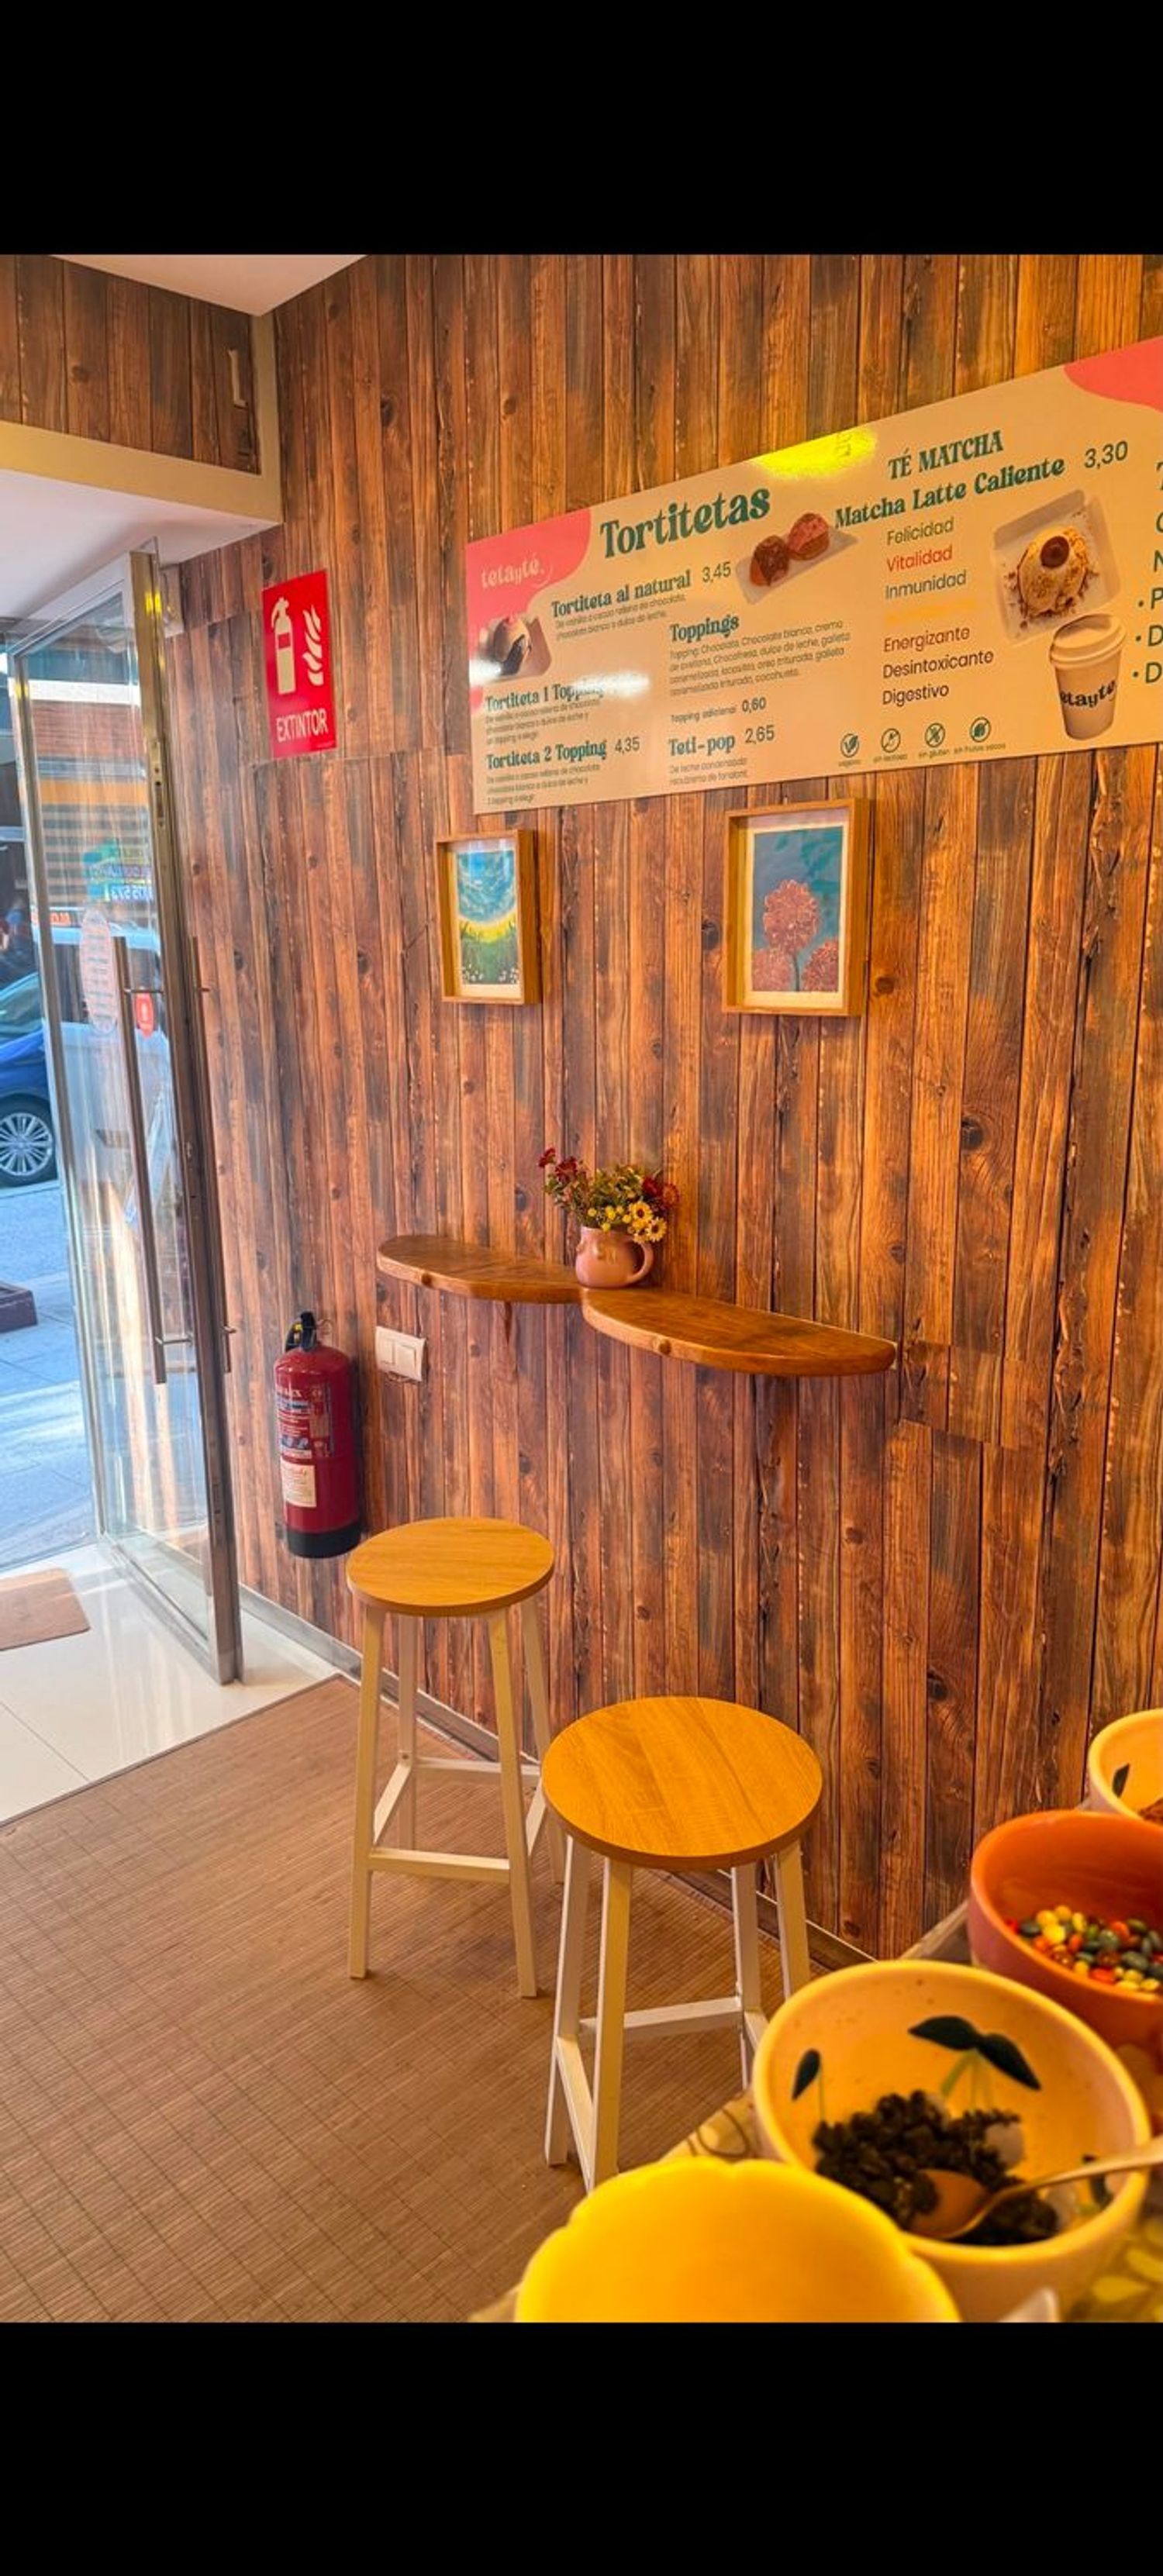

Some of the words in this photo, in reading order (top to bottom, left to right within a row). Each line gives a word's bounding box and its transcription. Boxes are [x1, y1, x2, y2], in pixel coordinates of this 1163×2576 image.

[889, 448, 912, 479] TÉ
[919, 430, 1003, 473] MATCHA
[835, 498, 906, 529] Matcha
[913, 481, 967, 510] Latte
[974, 458, 1065, 494] Caliente
[1085, 441, 1128, 469] 3,30
[600, 488, 771, 558] Tortitetas
[887, 516, 954, 546] Felicidad
[887, 545, 953, 572] Vitalidad
[551, 595, 612, 618] Tortiteta
[616, 585, 630, 602] al
[634, 569, 691, 598] natural
[702, 561, 731, 584] 3,45
[885, 570, 966, 599] Inmunidad
[669, 613, 740, 643] Toppings
[884, 627, 971, 652] Energizante
[883, 650, 994, 678] Desintoxicante
[485, 692, 540, 712] Tortiteta
[742, 697, 767, 713] 0,60
[883, 684, 949, 707] Digestivo
[276, 708, 329, 742] EXTINTOR
[745, 725, 775, 744] 2,65
[485, 750, 540, 770] Tortiteta
[544, 746, 552, 761] 2
[555, 740, 606, 762] Topping
[615, 736, 640, 754] 4,35
